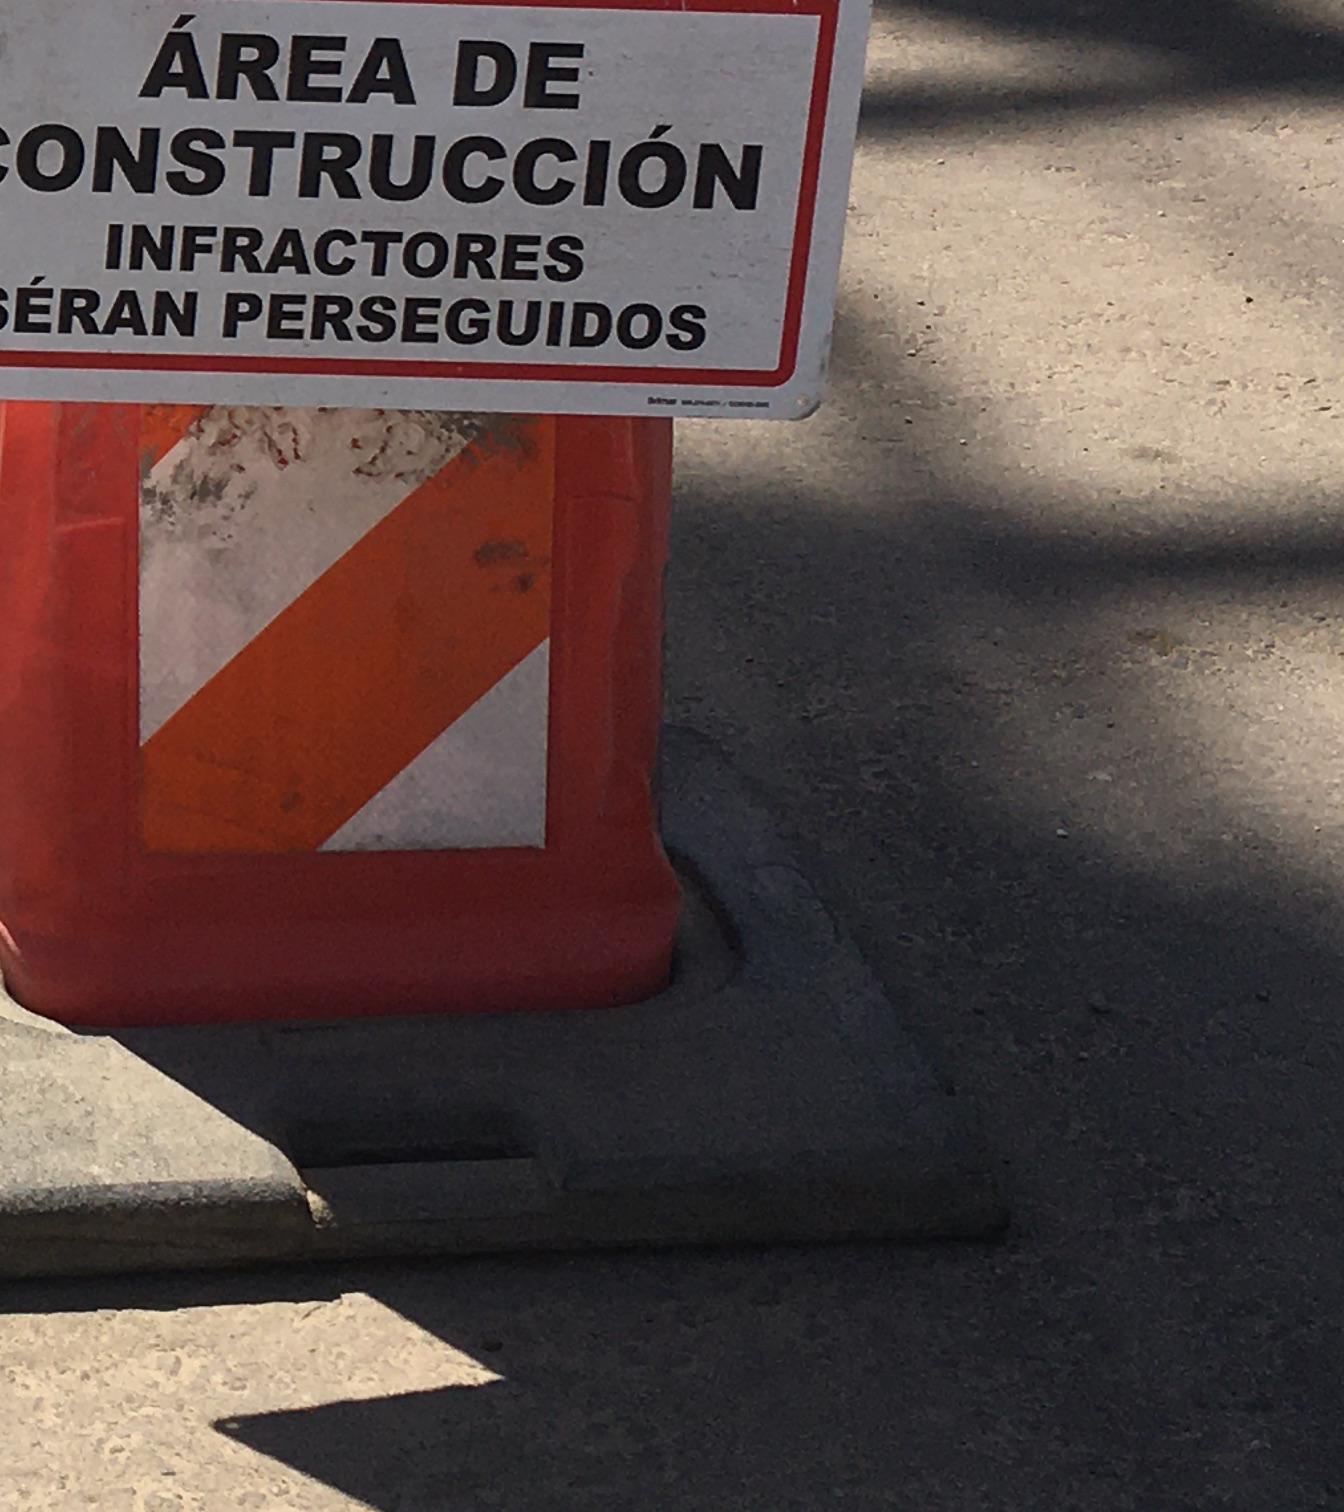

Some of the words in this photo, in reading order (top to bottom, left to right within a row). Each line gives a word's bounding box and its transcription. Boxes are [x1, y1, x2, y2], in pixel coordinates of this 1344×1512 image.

[137, 13, 417, 106] ÁREA
[452, 39, 586, 110] DE
[105, 223, 585, 283] INFRACTORES
[221, 292, 707, 351] PERSEGUIDOS
